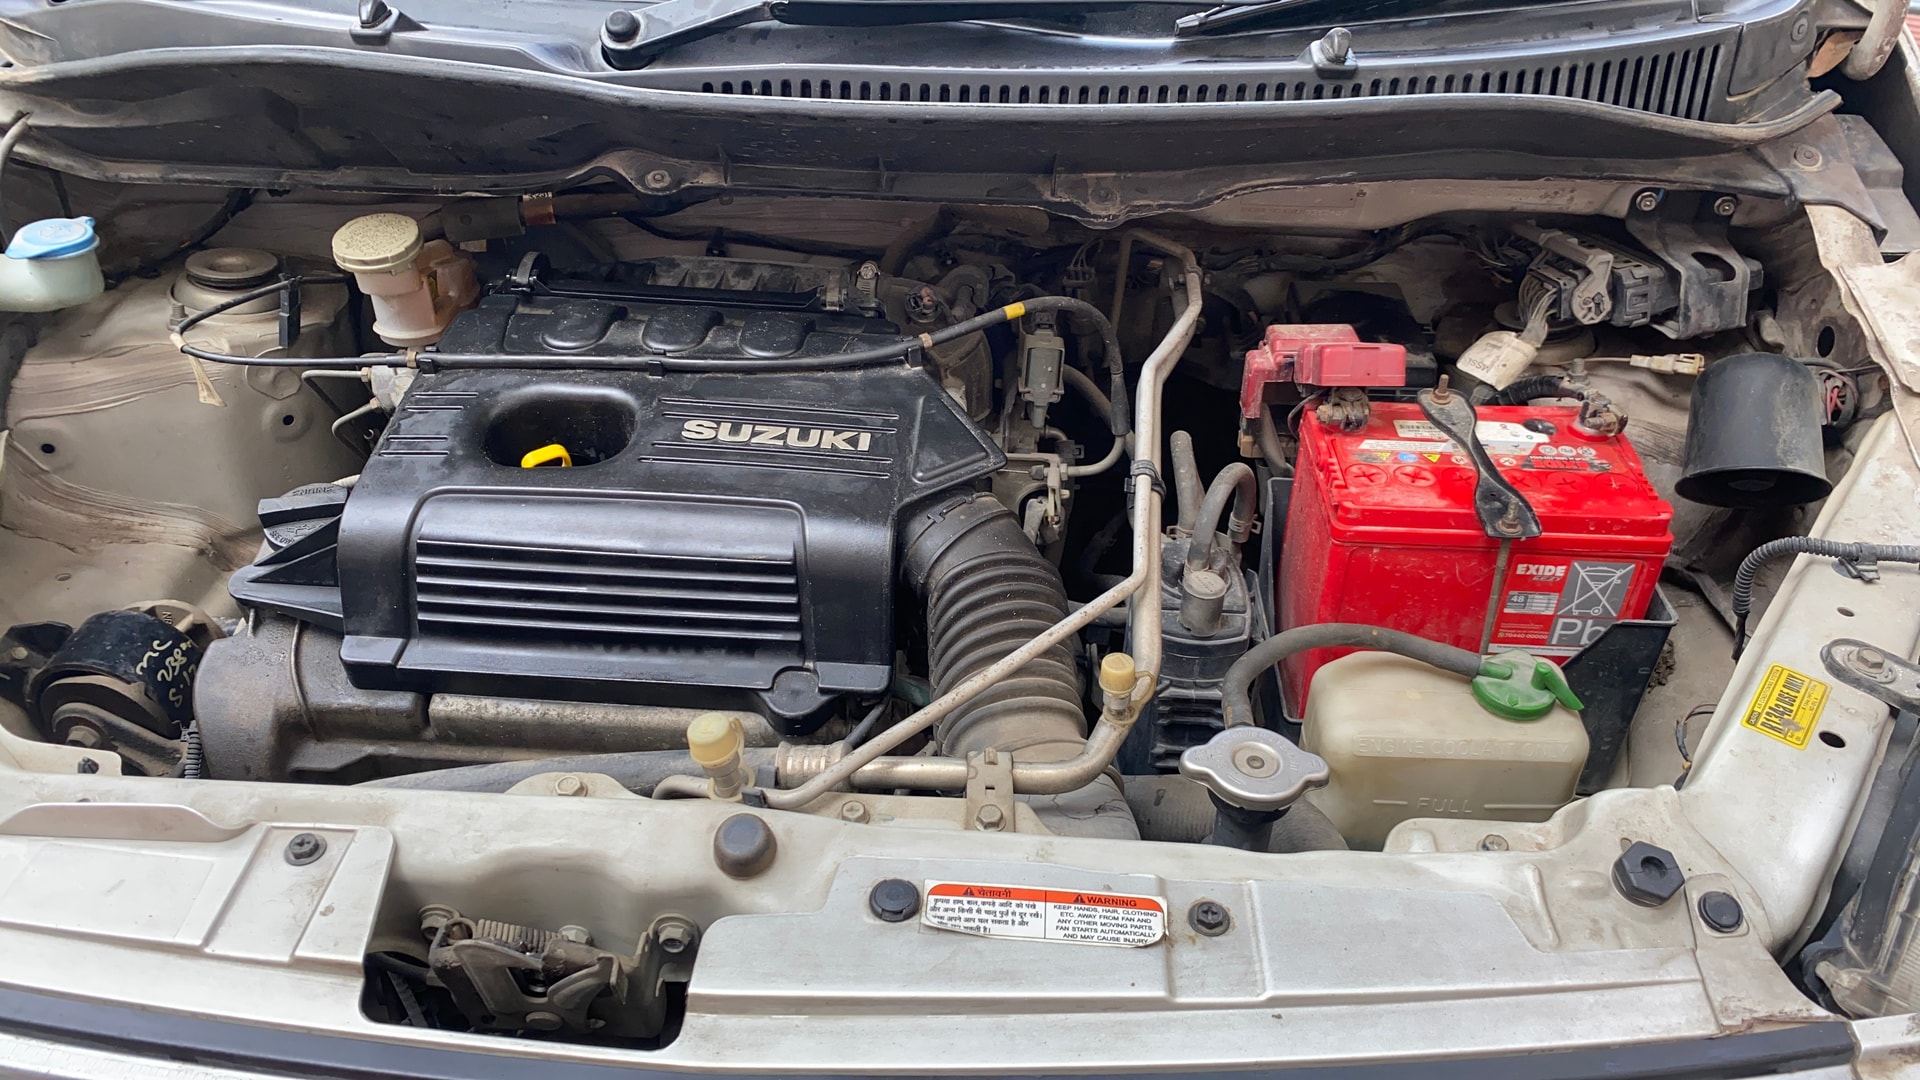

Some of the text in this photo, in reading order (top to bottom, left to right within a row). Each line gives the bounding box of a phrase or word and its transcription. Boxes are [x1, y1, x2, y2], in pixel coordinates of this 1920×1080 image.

[681, 419, 872, 452] SUZUKI
[1516, 564, 1567, 576] EXIDE
[1510, 595, 1525, 603] 48
[1782, 673, 1805, 694] ONLY
[1775, 690, 1798, 707] USE
[1760, 703, 1794, 735] R134a
[1358, 737, 1572, 759] ENGINE COOLANT ONLY
[1416, 797, 1473, 813] FULL
[977, 888, 1011, 897] चेतावनी
[1087, 896, 1137, 907] WARNING
[1074, 905, 1100, 913] HANDS,
[1102, 907, 1120, 915] HAIR,
[1122, 909, 1158, 918] CLOTHING
[1073, 919, 1098, 927] OTHER
[1100, 921, 1128, 929] MOVING
[1072, 926, 1098, 934] STARTS
[1099, 928, 1157, 938] AUTOMATICALLY
